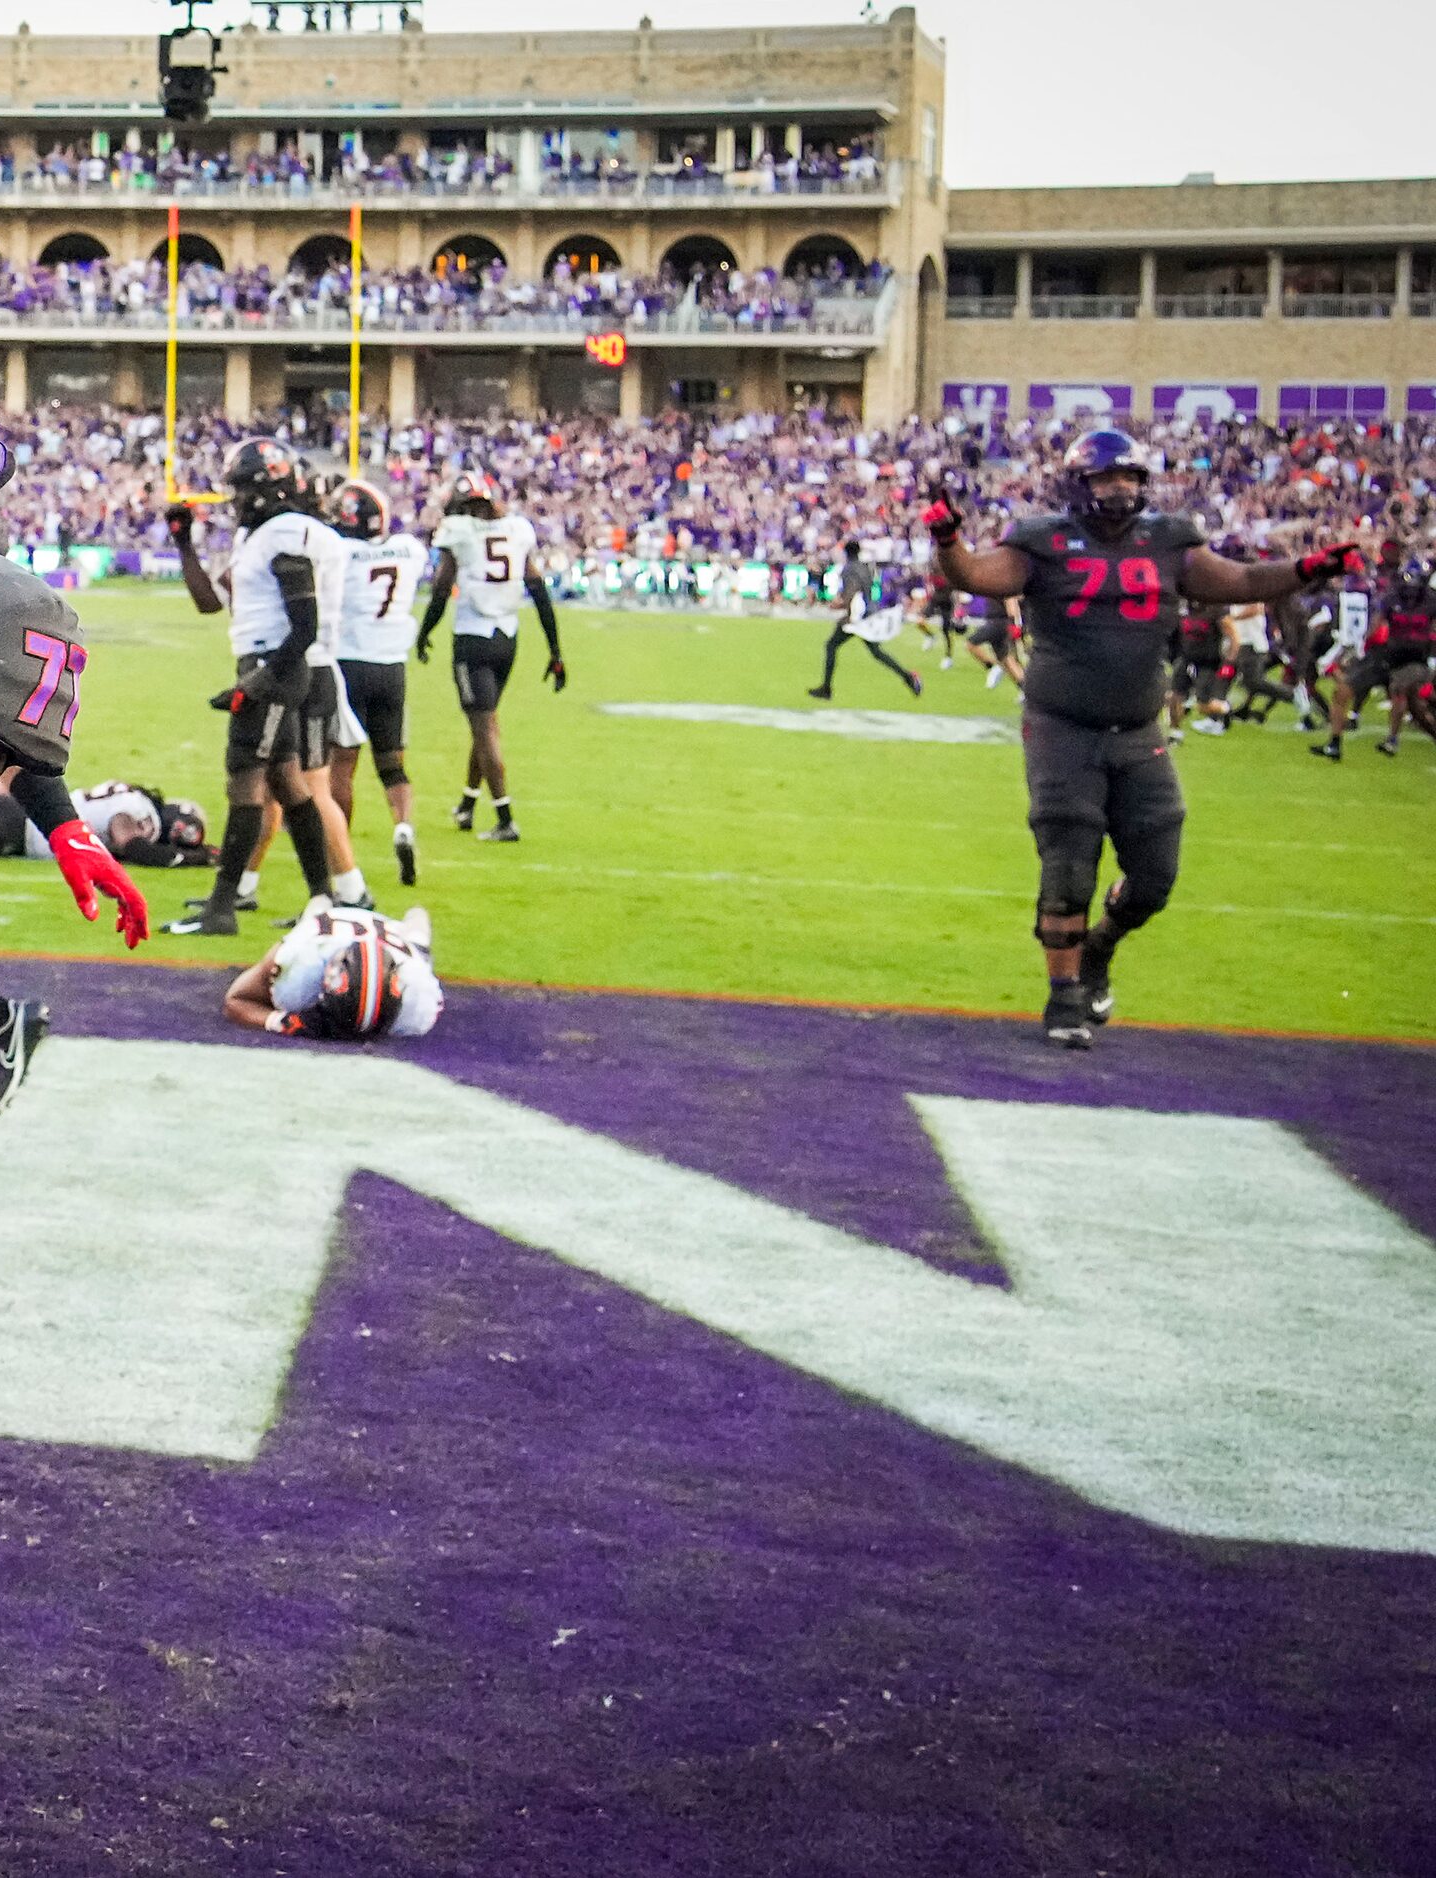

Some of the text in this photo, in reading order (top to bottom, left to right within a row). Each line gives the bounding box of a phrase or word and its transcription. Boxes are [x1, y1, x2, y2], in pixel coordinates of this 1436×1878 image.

[586, 334, 626, 366] 40
[486, 537, 510, 582] 5
[370, 566, 398, 619] 7
[1066, 557, 1161, 621] 79
